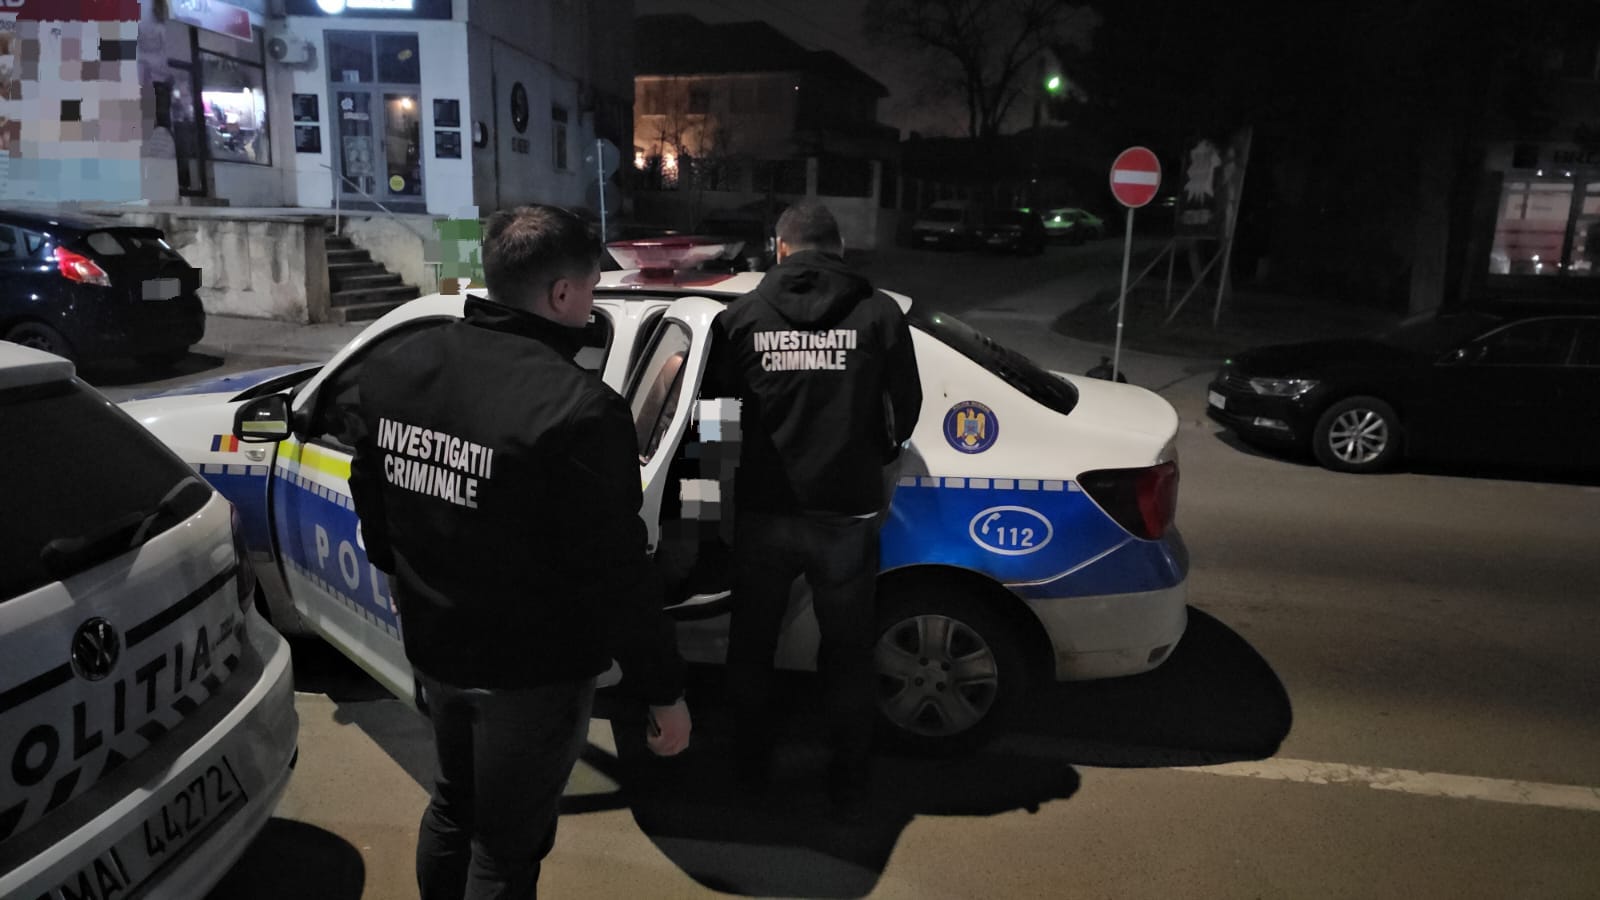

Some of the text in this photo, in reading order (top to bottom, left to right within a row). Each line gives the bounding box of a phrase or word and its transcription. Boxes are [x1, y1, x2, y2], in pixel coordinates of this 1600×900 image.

[753, 329, 858, 352] INVESTIGATII
[761, 350, 848, 372] CRIMINALE
[377, 417, 494, 480] INVESTIGATII
[384, 453, 479, 509] CRIMINALE
[314, 522, 389, 610] POL
[996, 526, 1035, 547] 112
[11, 624, 213, 787] OLITIA
[143, 763, 234, 857] 44272
